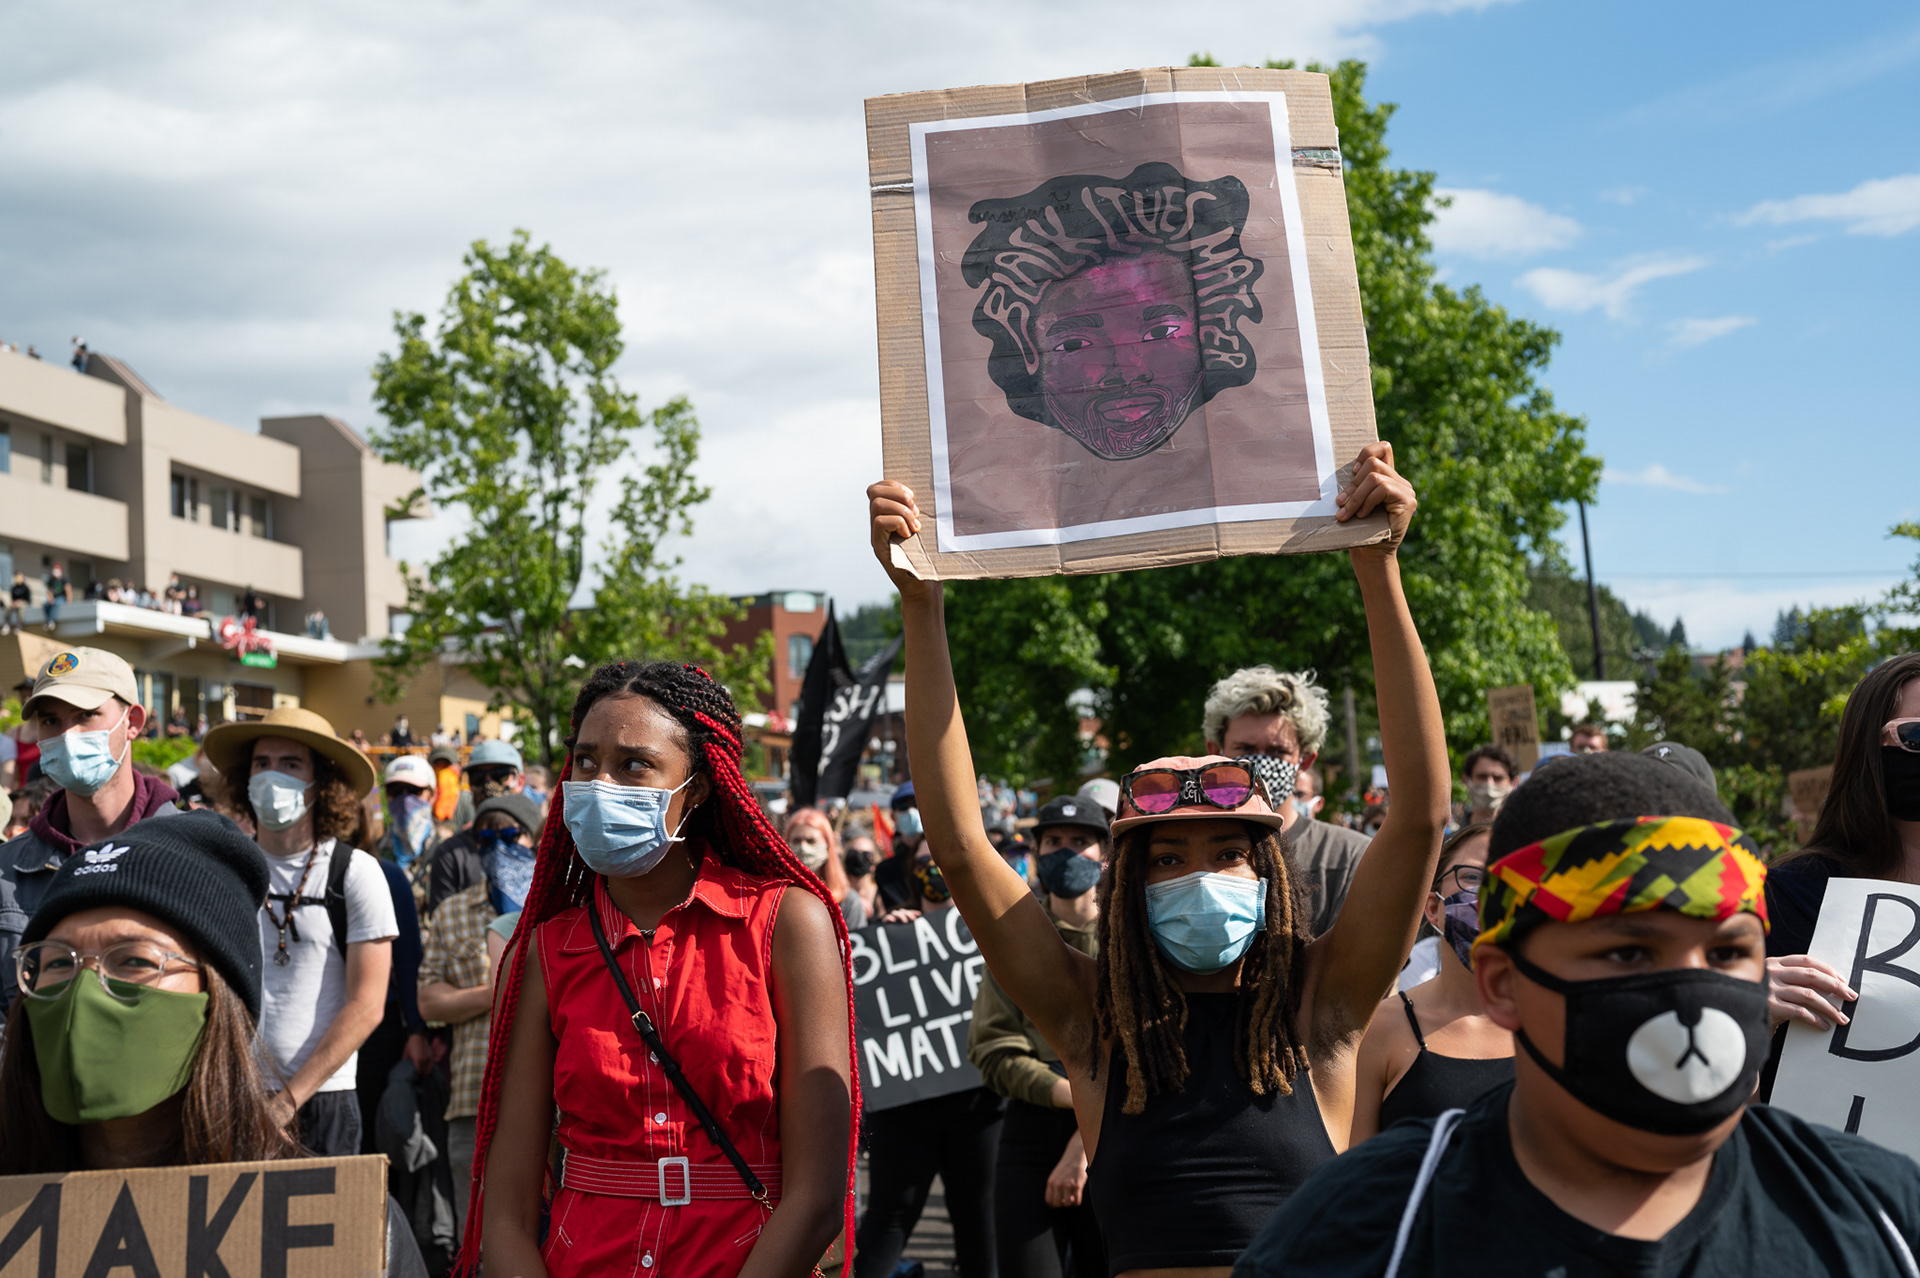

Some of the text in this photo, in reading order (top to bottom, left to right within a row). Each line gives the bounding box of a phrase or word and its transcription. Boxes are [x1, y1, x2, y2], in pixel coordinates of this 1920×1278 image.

[1081, 186, 1217, 254] LIVES
[1165, 227, 1254, 369] MATTER
[74, 863, 118, 876] adidas
[848, 905, 979, 986] BLAC
[876, 954, 985, 1028] LIVE
[0, 1166, 336, 1278] MAKE
